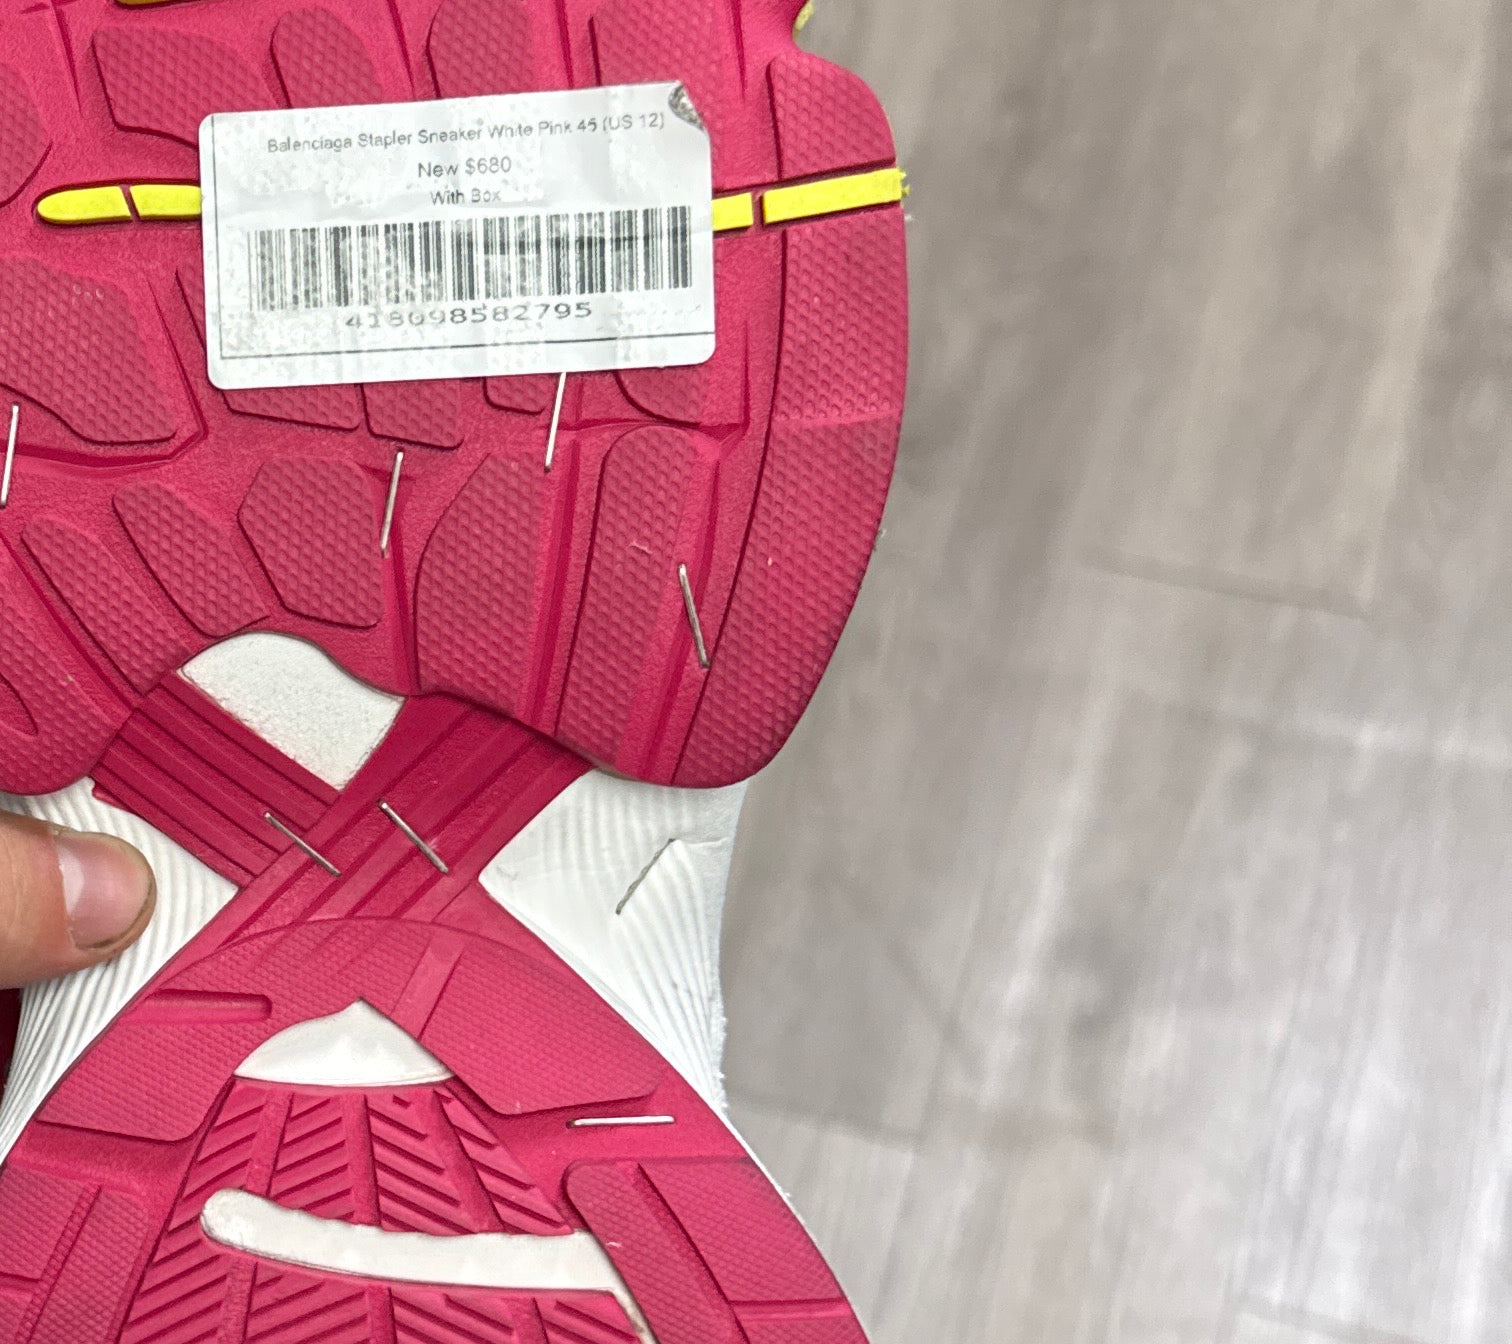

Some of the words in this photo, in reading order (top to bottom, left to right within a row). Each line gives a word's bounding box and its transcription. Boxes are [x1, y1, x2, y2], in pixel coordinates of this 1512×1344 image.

[267, 136, 352, 153] Balenciaga
[357, 130, 413, 149] Stapler
[418, 127, 482, 144] Sneaker
[489, 123, 533, 139] White
[538, 121, 573, 136] Pink
[577, 118, 598, 132] 45
[603, 114, 633, 131] (US
[639, 112, 664, 130] 12)
[418, 161, 459, 178] New
[464, 156, 512, 175] $680
[430, 189, 465, 205] With
[471, 187, 501, 203] Box
[345, 301, 593, 329] 418098582795
